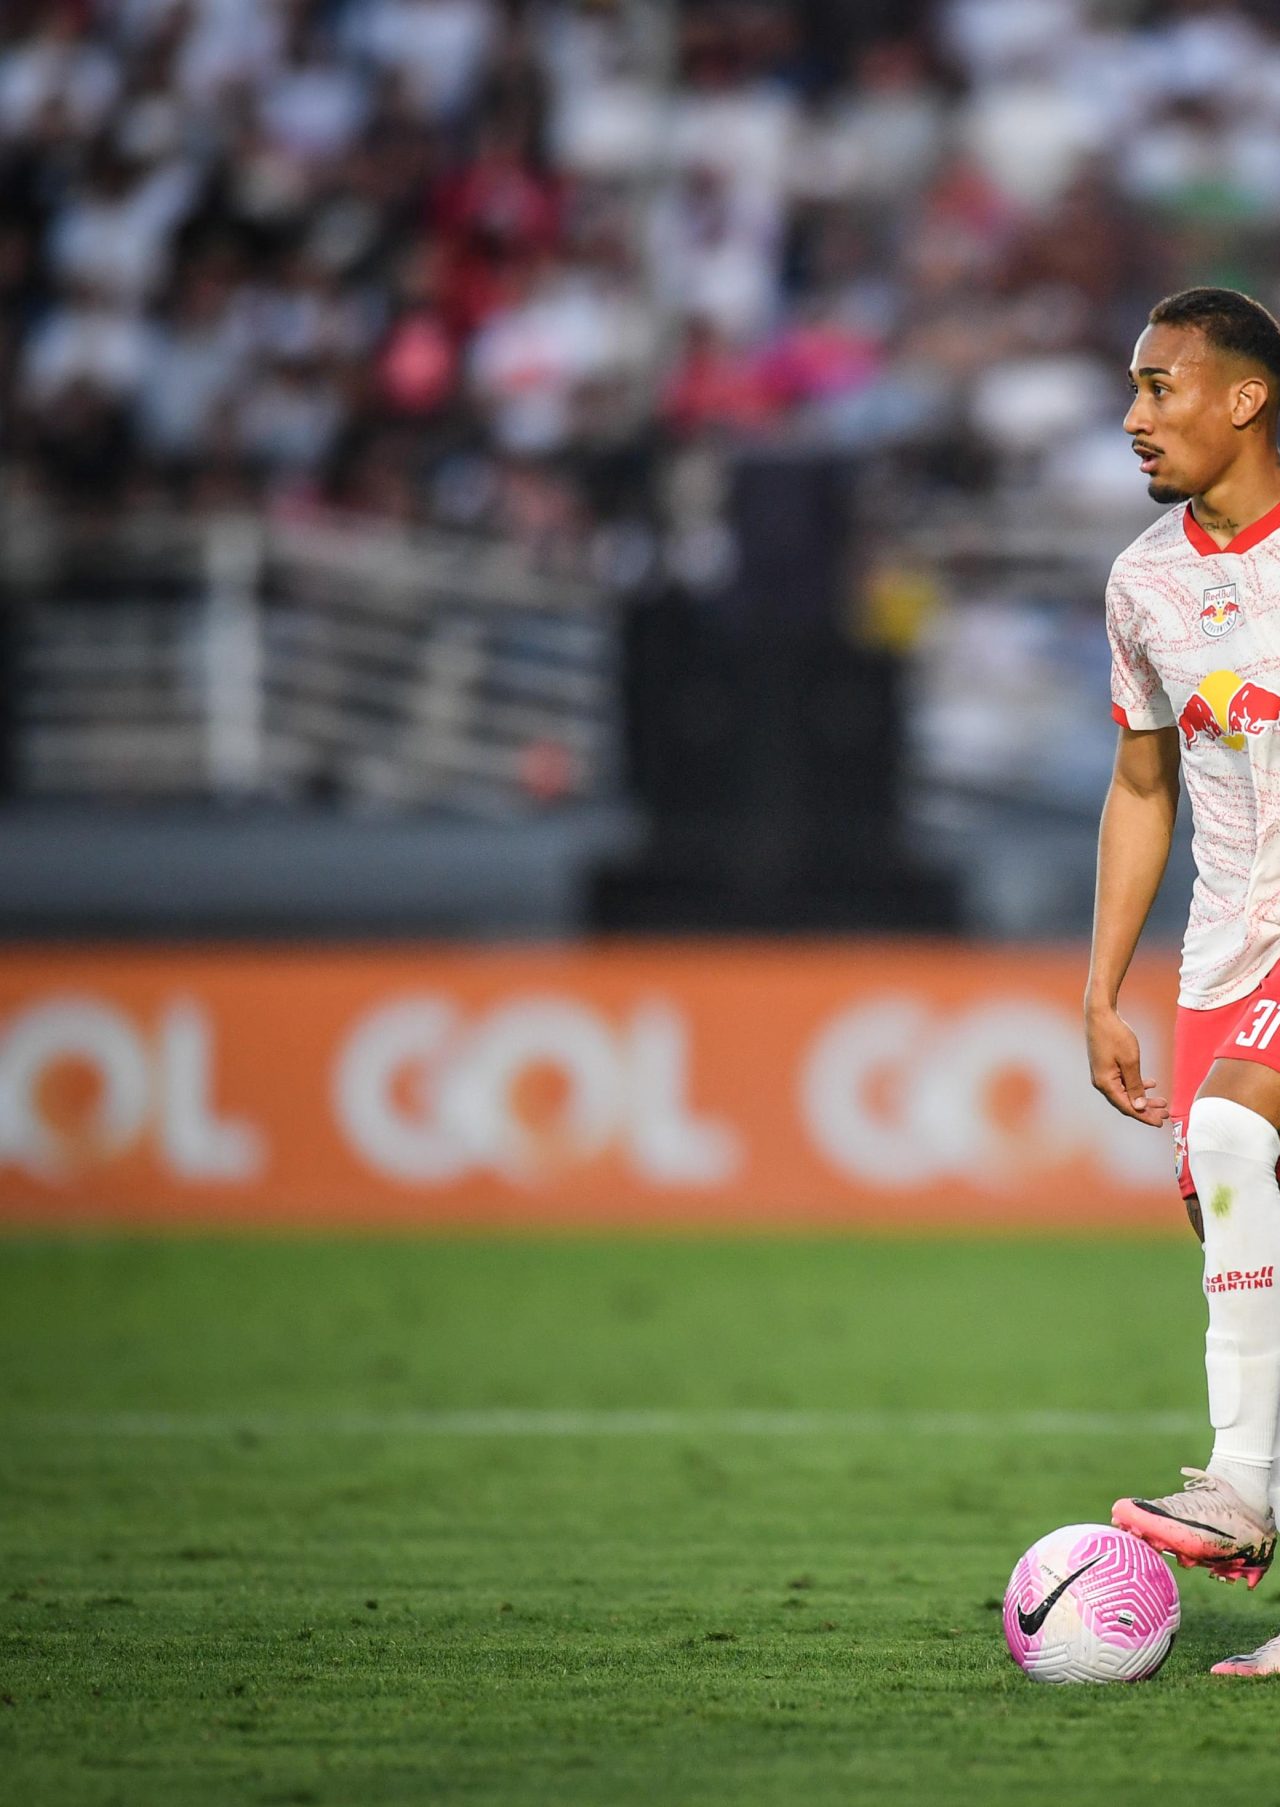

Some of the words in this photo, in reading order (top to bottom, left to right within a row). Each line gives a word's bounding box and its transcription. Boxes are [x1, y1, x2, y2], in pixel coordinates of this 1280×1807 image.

[0, 993, 264, 1185] OL
[333, 993, 744, 1187] GOL
[1206, 1279, 1273, 1293] GANTINO
[1227, 1266, 1273, 1281] Bull
